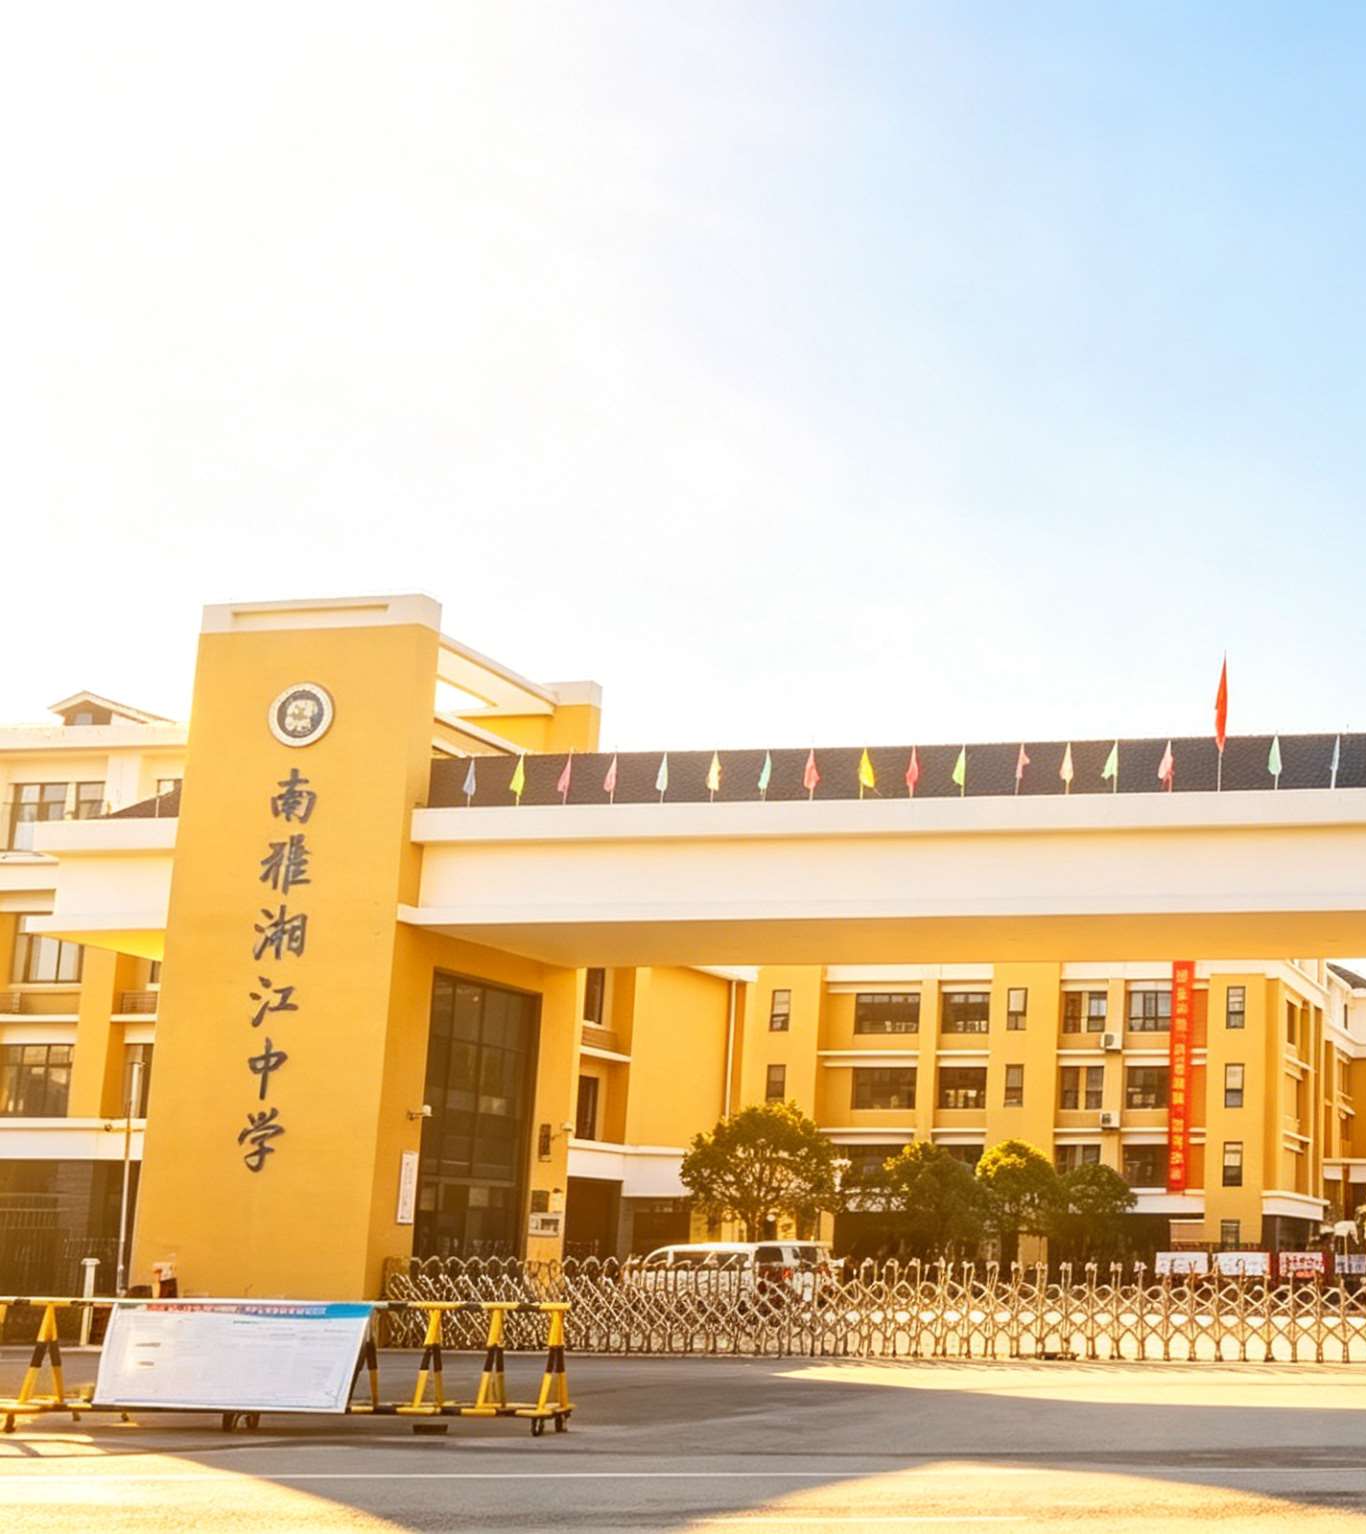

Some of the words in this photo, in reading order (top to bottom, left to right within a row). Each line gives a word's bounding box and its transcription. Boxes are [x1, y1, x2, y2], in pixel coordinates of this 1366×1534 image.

[238, 768, 317, 1172] 南雅湘江中学
